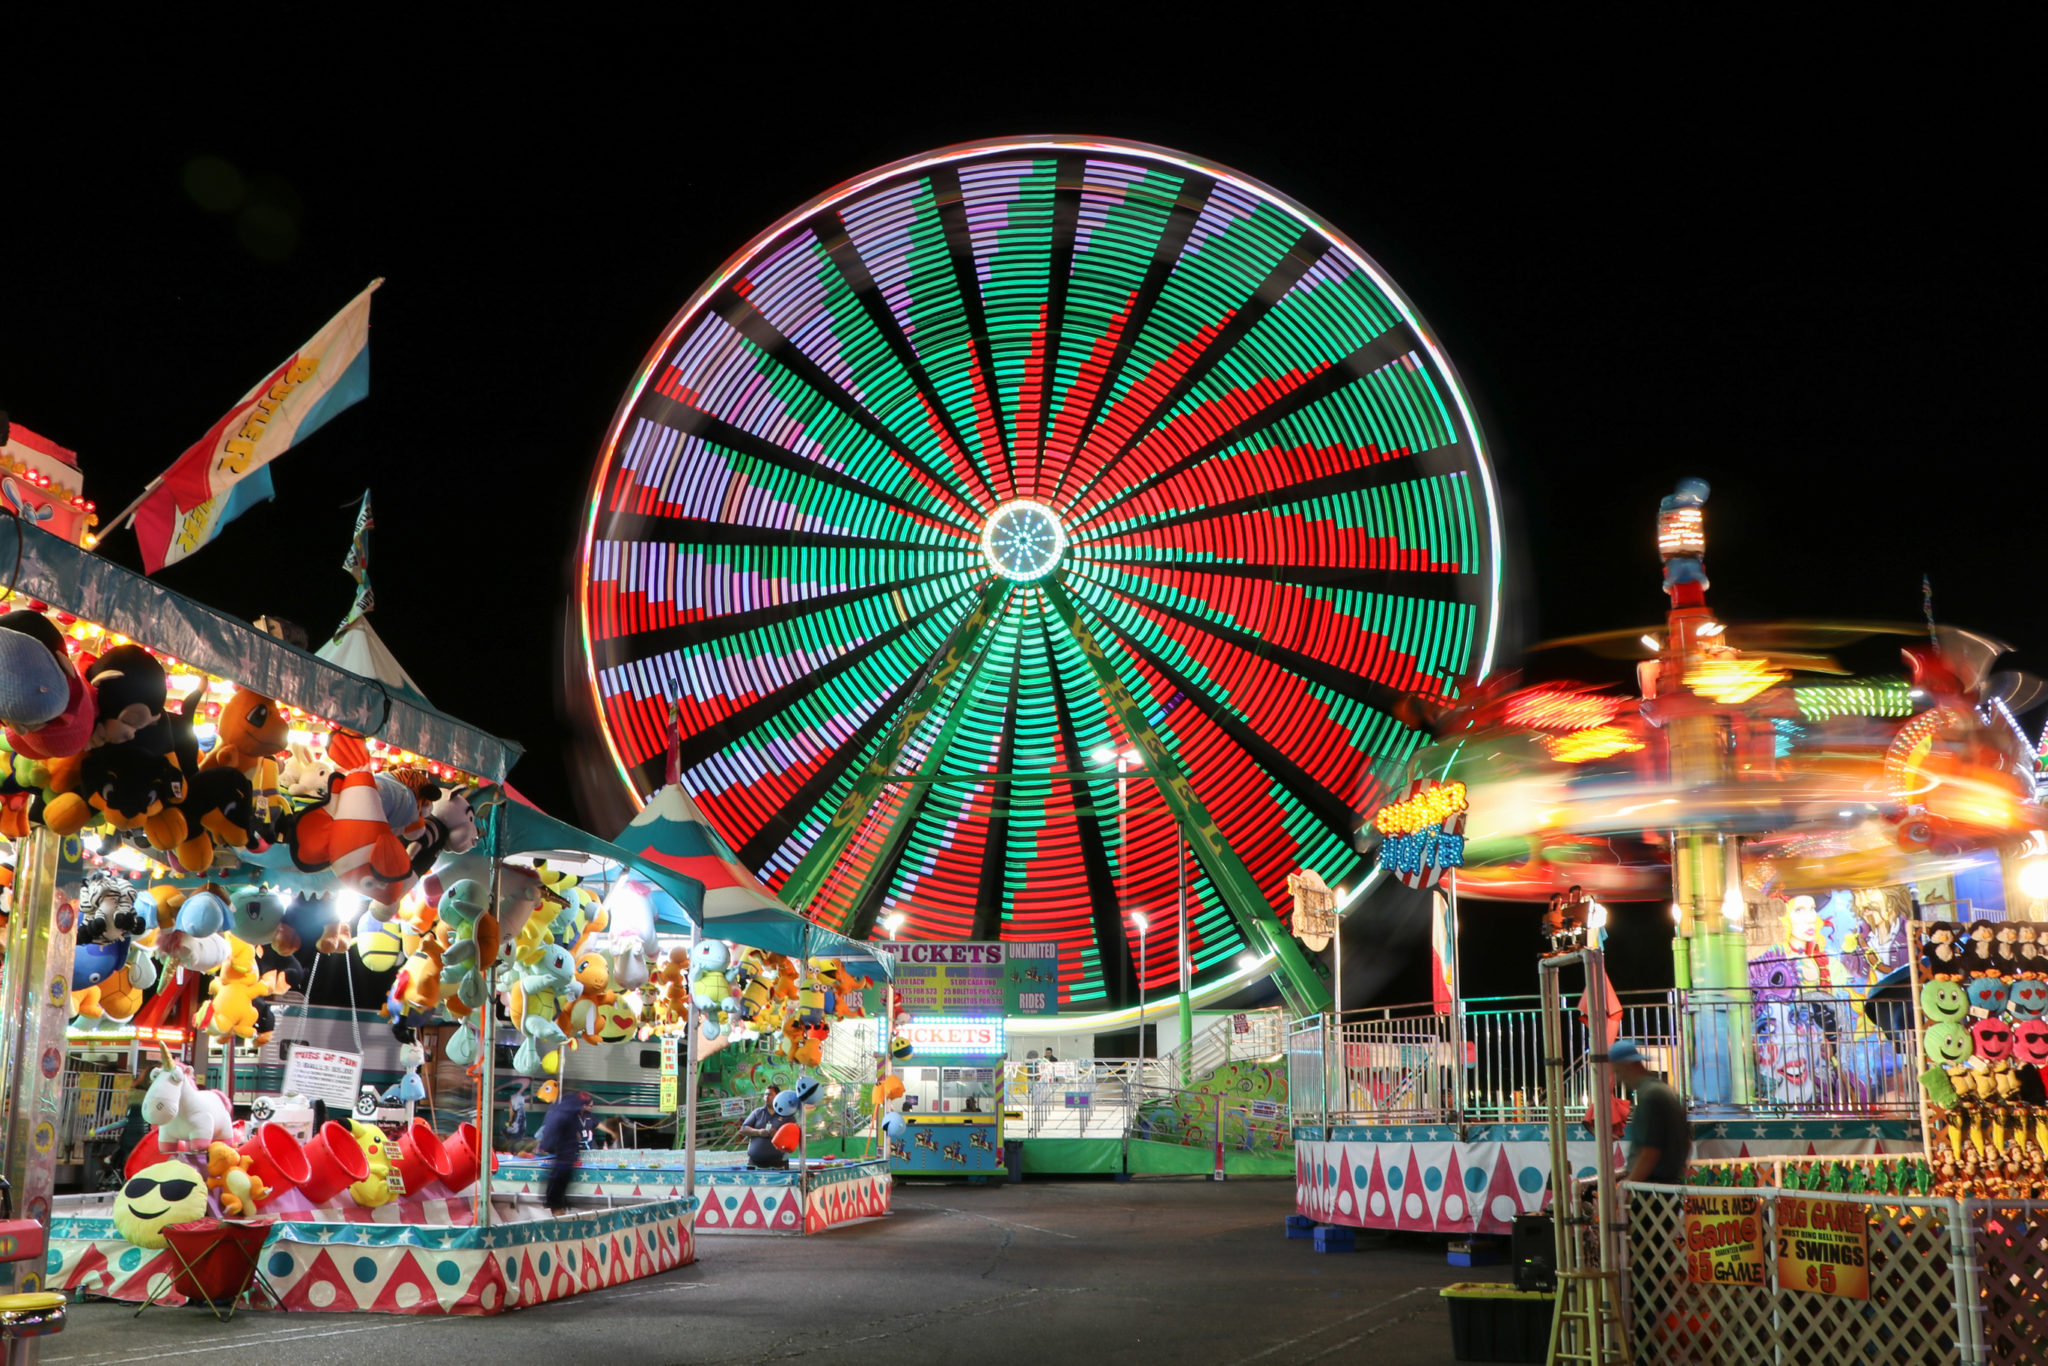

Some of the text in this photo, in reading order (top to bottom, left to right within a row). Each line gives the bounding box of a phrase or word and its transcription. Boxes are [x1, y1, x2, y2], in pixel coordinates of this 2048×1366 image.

[217, 358, 320, 473] BUTLER
[832, 598, 986, 828] GIANT
[1071, 613, 1222, 857] WHEEL
[882, 944, 1002, 963] TICKETS
[1009, 943, 1056, 959] UNLIMITED
[1019, 992, 1046, 1009] RIDES
[1686, 1198, 1757, 1215] SMALL & MED
[1779, 1199, 1864, 1233] BIG GAME
[1688, 1217, 1757, 1252] Game
[1819, 1232, 1832, 1241] BELL
[1834, 1234, 1843, 1242] TO
[1688, 1252, 1763, 1282] $5 GAME
[1779, 1237, 1865, 1267] 2 SWINGS
[1806, 1264, 1837, 1293] $5
